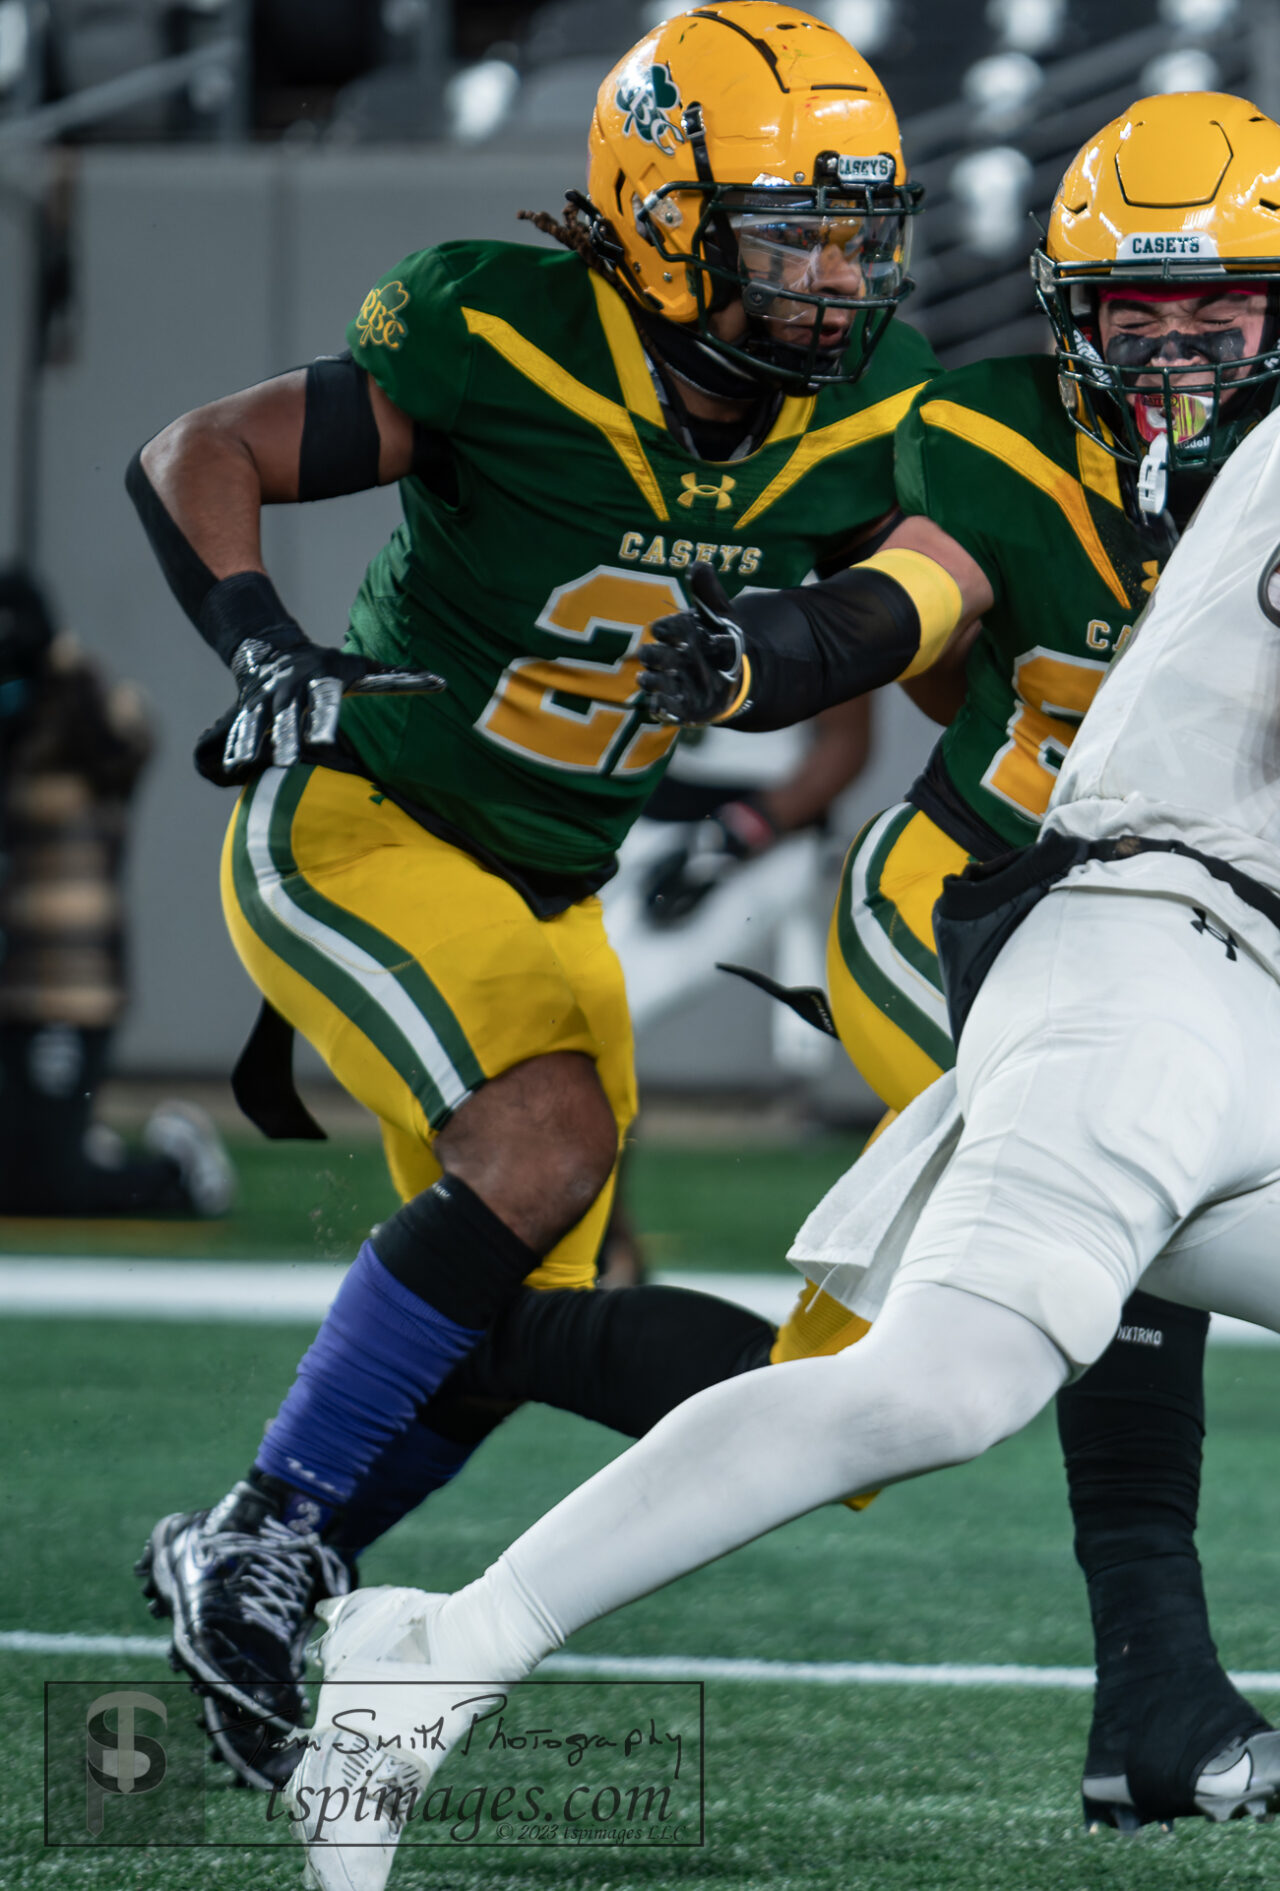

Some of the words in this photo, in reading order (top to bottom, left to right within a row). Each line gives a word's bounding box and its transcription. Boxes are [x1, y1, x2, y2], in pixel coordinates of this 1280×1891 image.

[839, 158, 889, 176] CASEYS
[1132, 236, 1200, 254] CASEYS
[618, 531, 762, 574] CASEYS
[474, 564, 715, 777] 2
